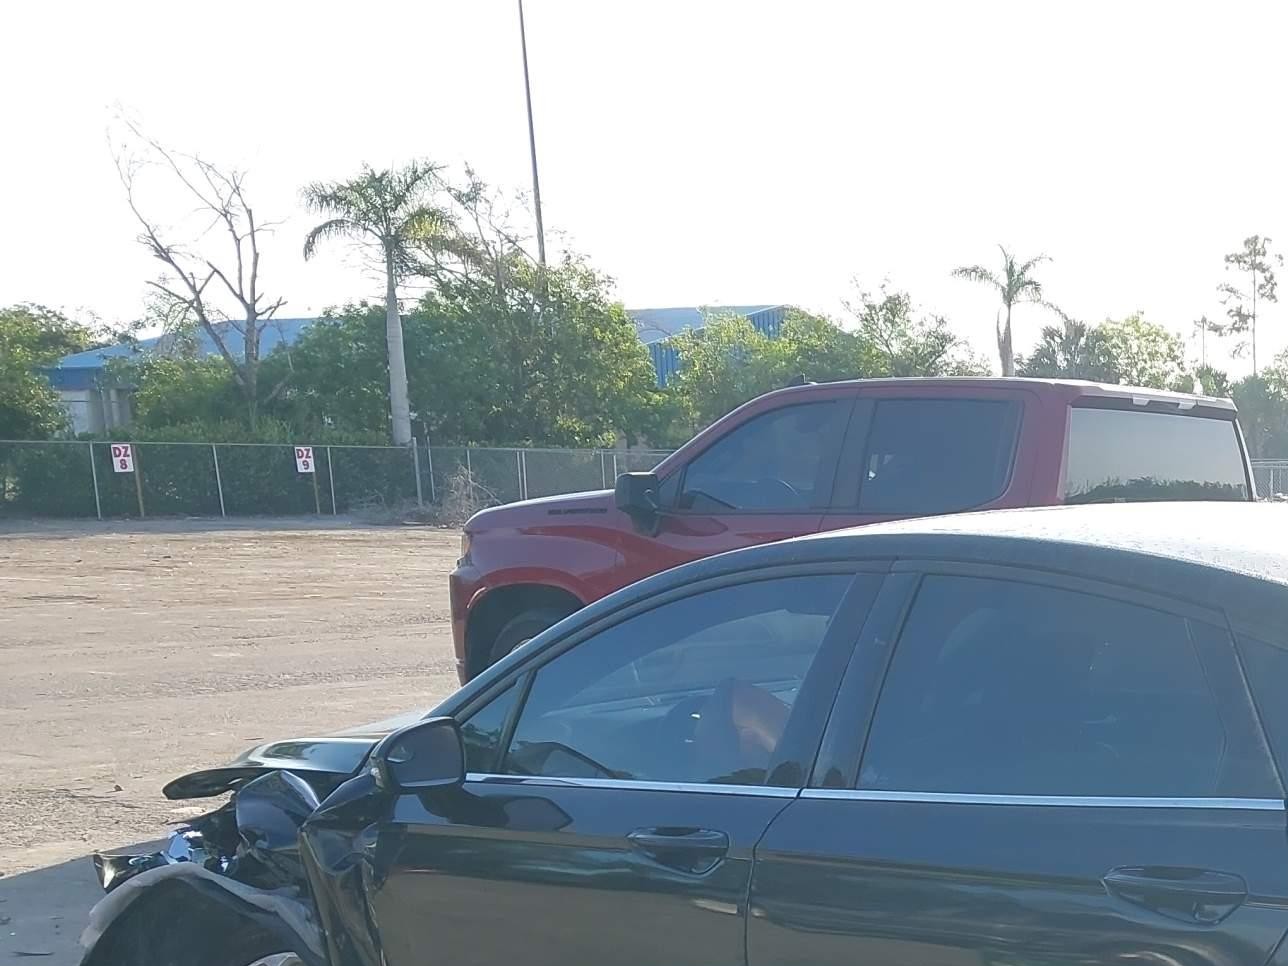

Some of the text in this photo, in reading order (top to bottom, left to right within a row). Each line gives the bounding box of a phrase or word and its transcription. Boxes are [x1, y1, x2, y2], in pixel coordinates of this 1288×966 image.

[112, 446, 130, 458] DZ
[296, 448, 312, 459] DZ
[119, 459, 128, 470] 8
[302, 460, 311, 470] 9
